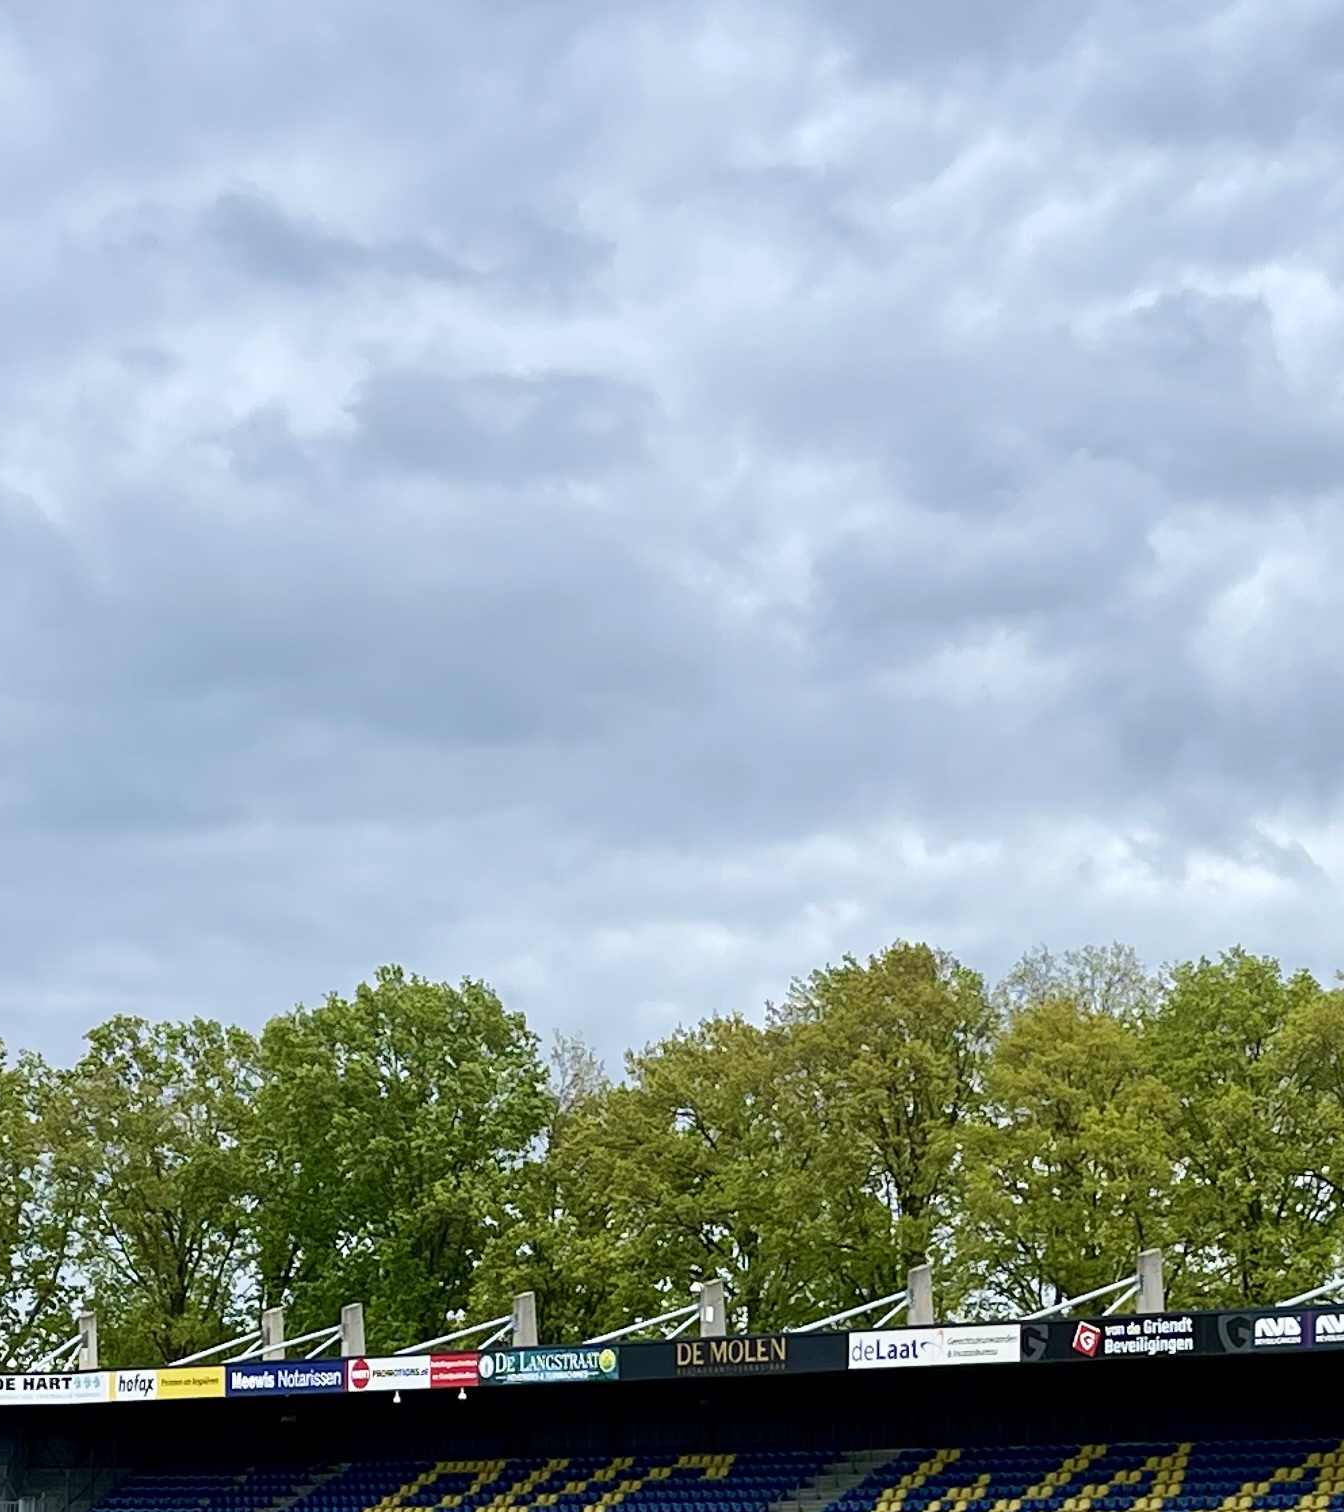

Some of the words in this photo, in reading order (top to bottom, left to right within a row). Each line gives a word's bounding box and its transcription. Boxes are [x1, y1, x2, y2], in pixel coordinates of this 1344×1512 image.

[1104, 1326, 1125, 1337] van
[1127, 1322, 1141, 1336] de
[1143, 1316, 1193, 1335] Griendt
[676, 1342, 705, 1366] DE
[709, 1337, 787, 1364] MOLEN
[1104, 1336, 1194, 1356] Beveiligingen
[22, 1376, 73, 1391] HART
[276, 1368, 342, 1389] Notarissen
